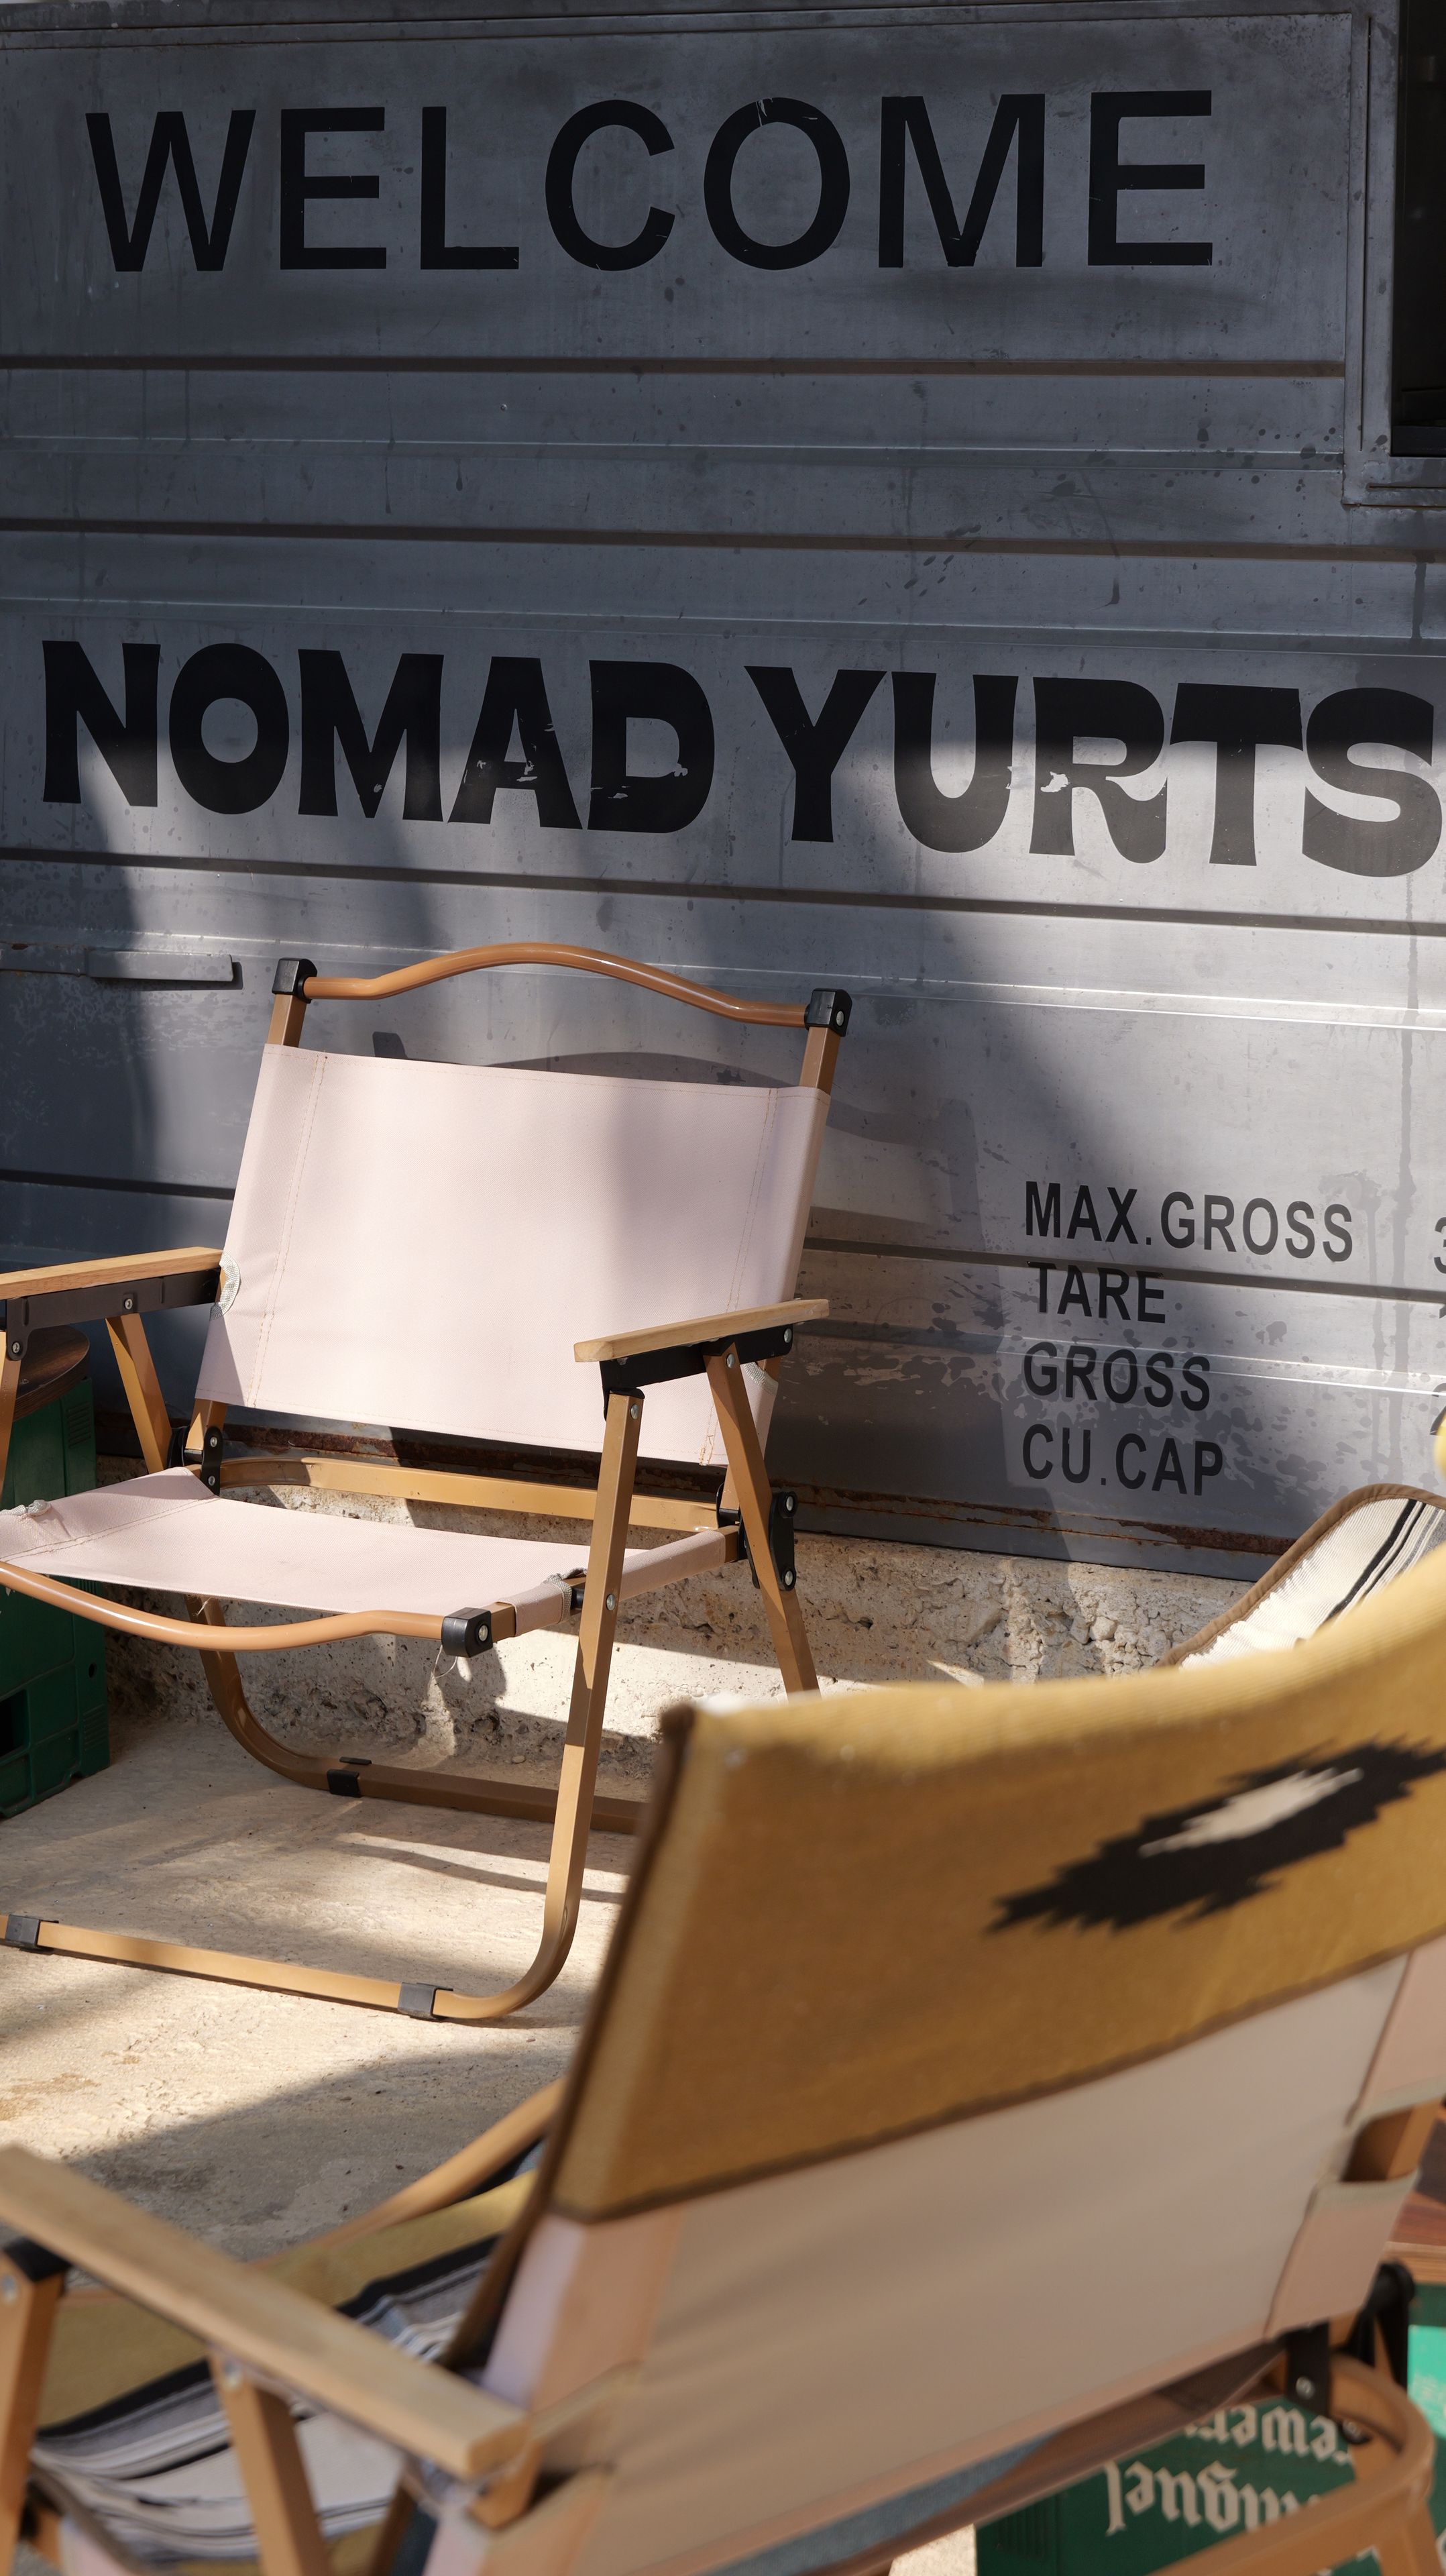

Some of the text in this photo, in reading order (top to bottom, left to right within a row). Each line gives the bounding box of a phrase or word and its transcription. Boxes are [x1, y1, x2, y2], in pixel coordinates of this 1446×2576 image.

[86, 89, 1214, 273] WELCOME
[42, 640, 1443, 877] NOMAD YURTS
[1025, 1181, 1353, 1262] MAX.GROSS
[1026, 1261, 1166, 1324] TARE
[1023, 1342, 1211, 1411] GROSS
[1022, 1424, 1223, 1497] CU.CAP
[1184, 2404, 1353, 2466] ewer
[1103, 2460, 1320, 2537] iguel
